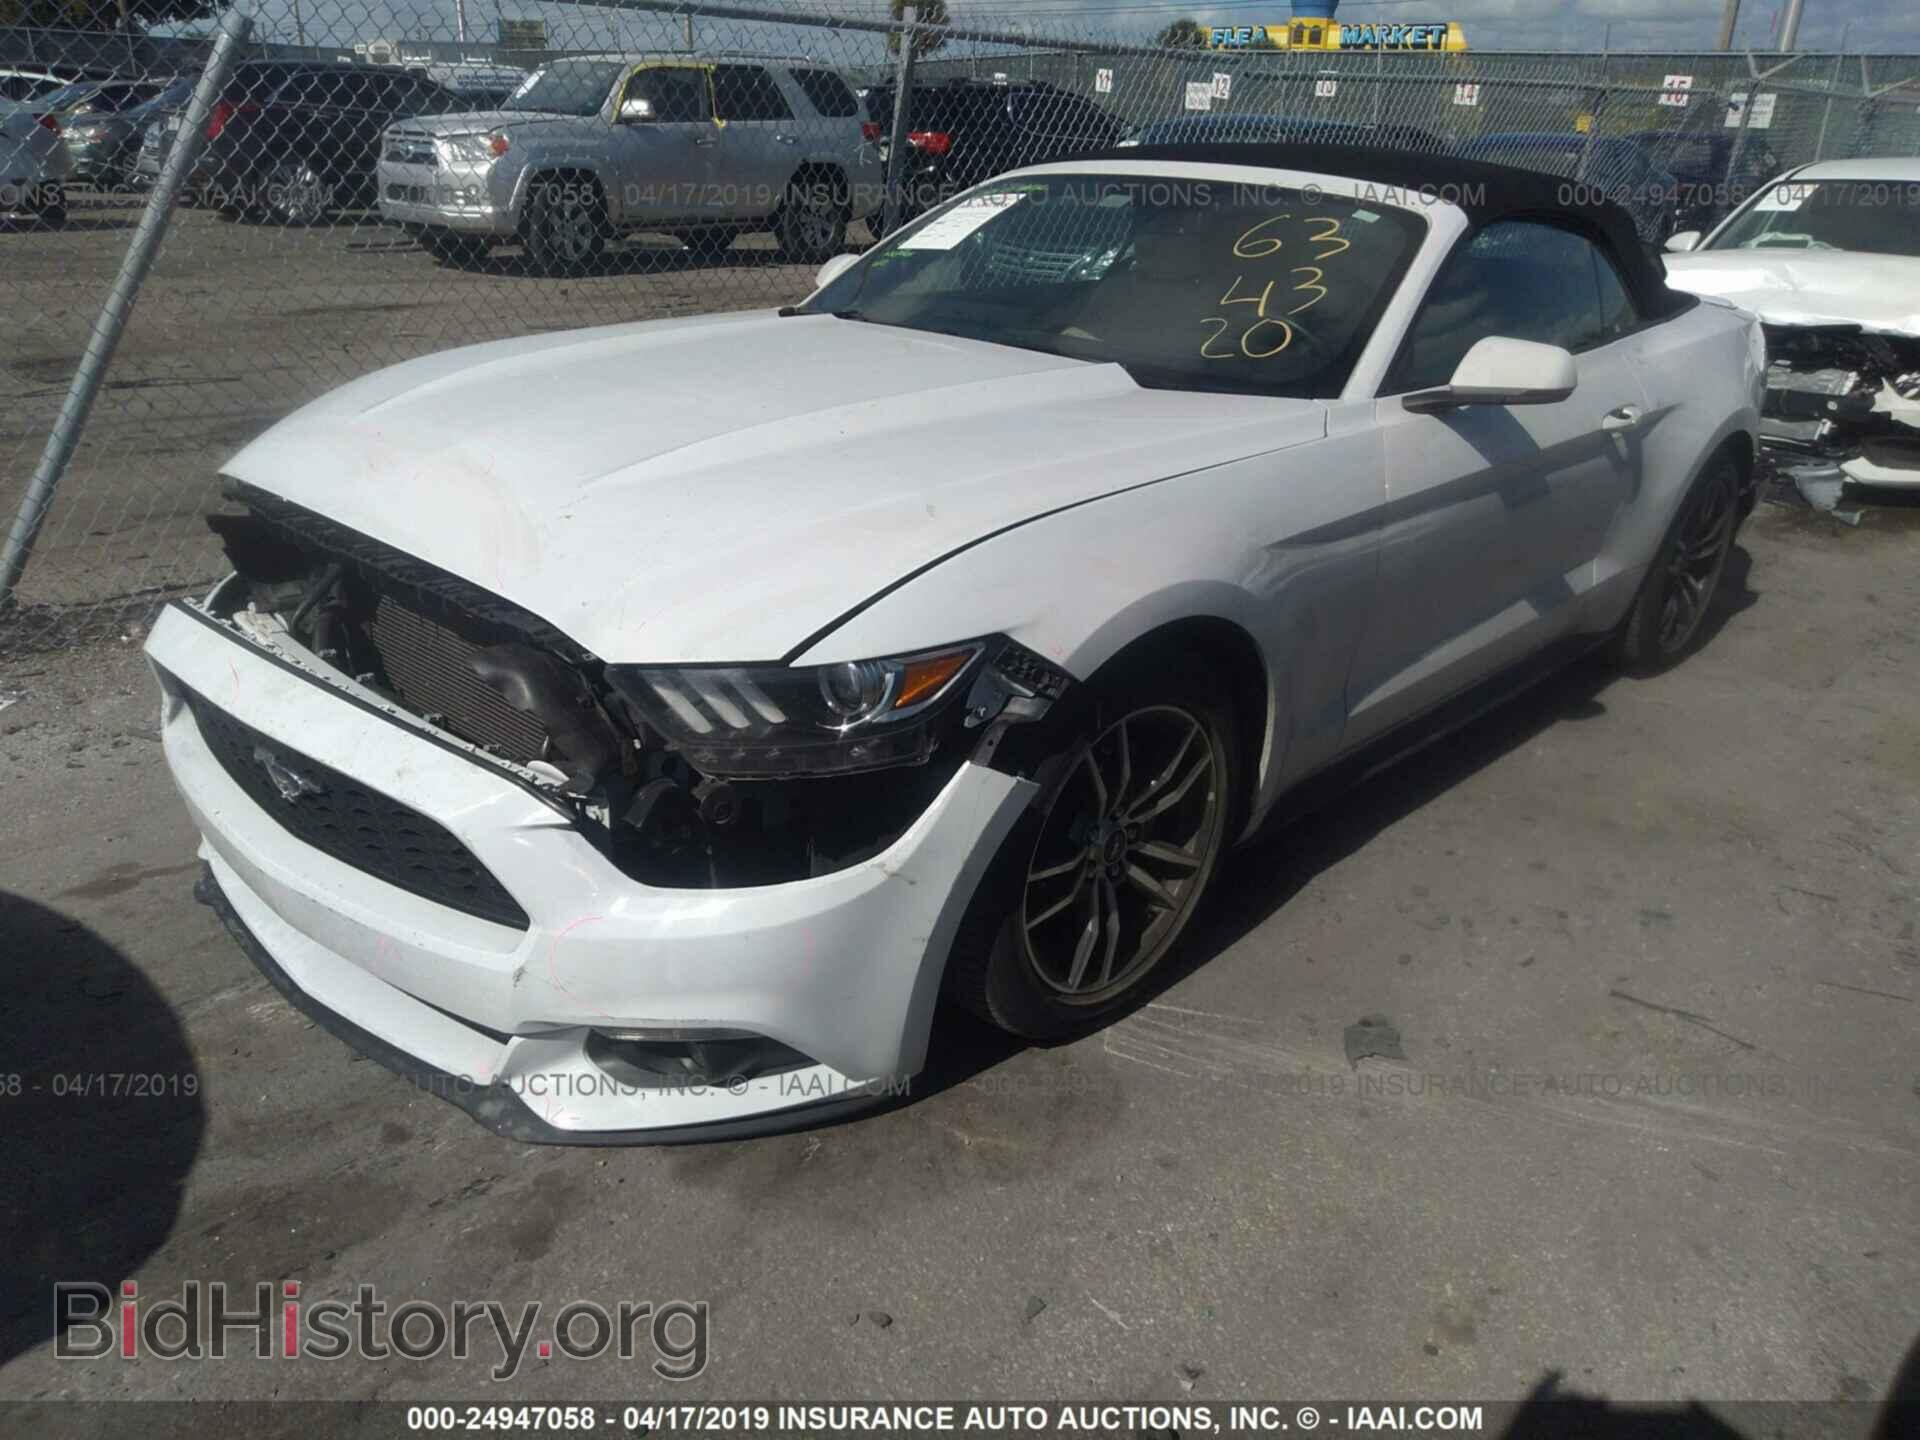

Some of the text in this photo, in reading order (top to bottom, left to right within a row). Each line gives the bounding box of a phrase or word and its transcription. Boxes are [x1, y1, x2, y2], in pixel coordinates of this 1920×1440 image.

[1211, 23, 1447, 49] FLEA MARKET
[1233, 214, 1350, 260] 63
[1220, 267, 1328, 318] 43
[1200, 317, 1292, 358] 20
